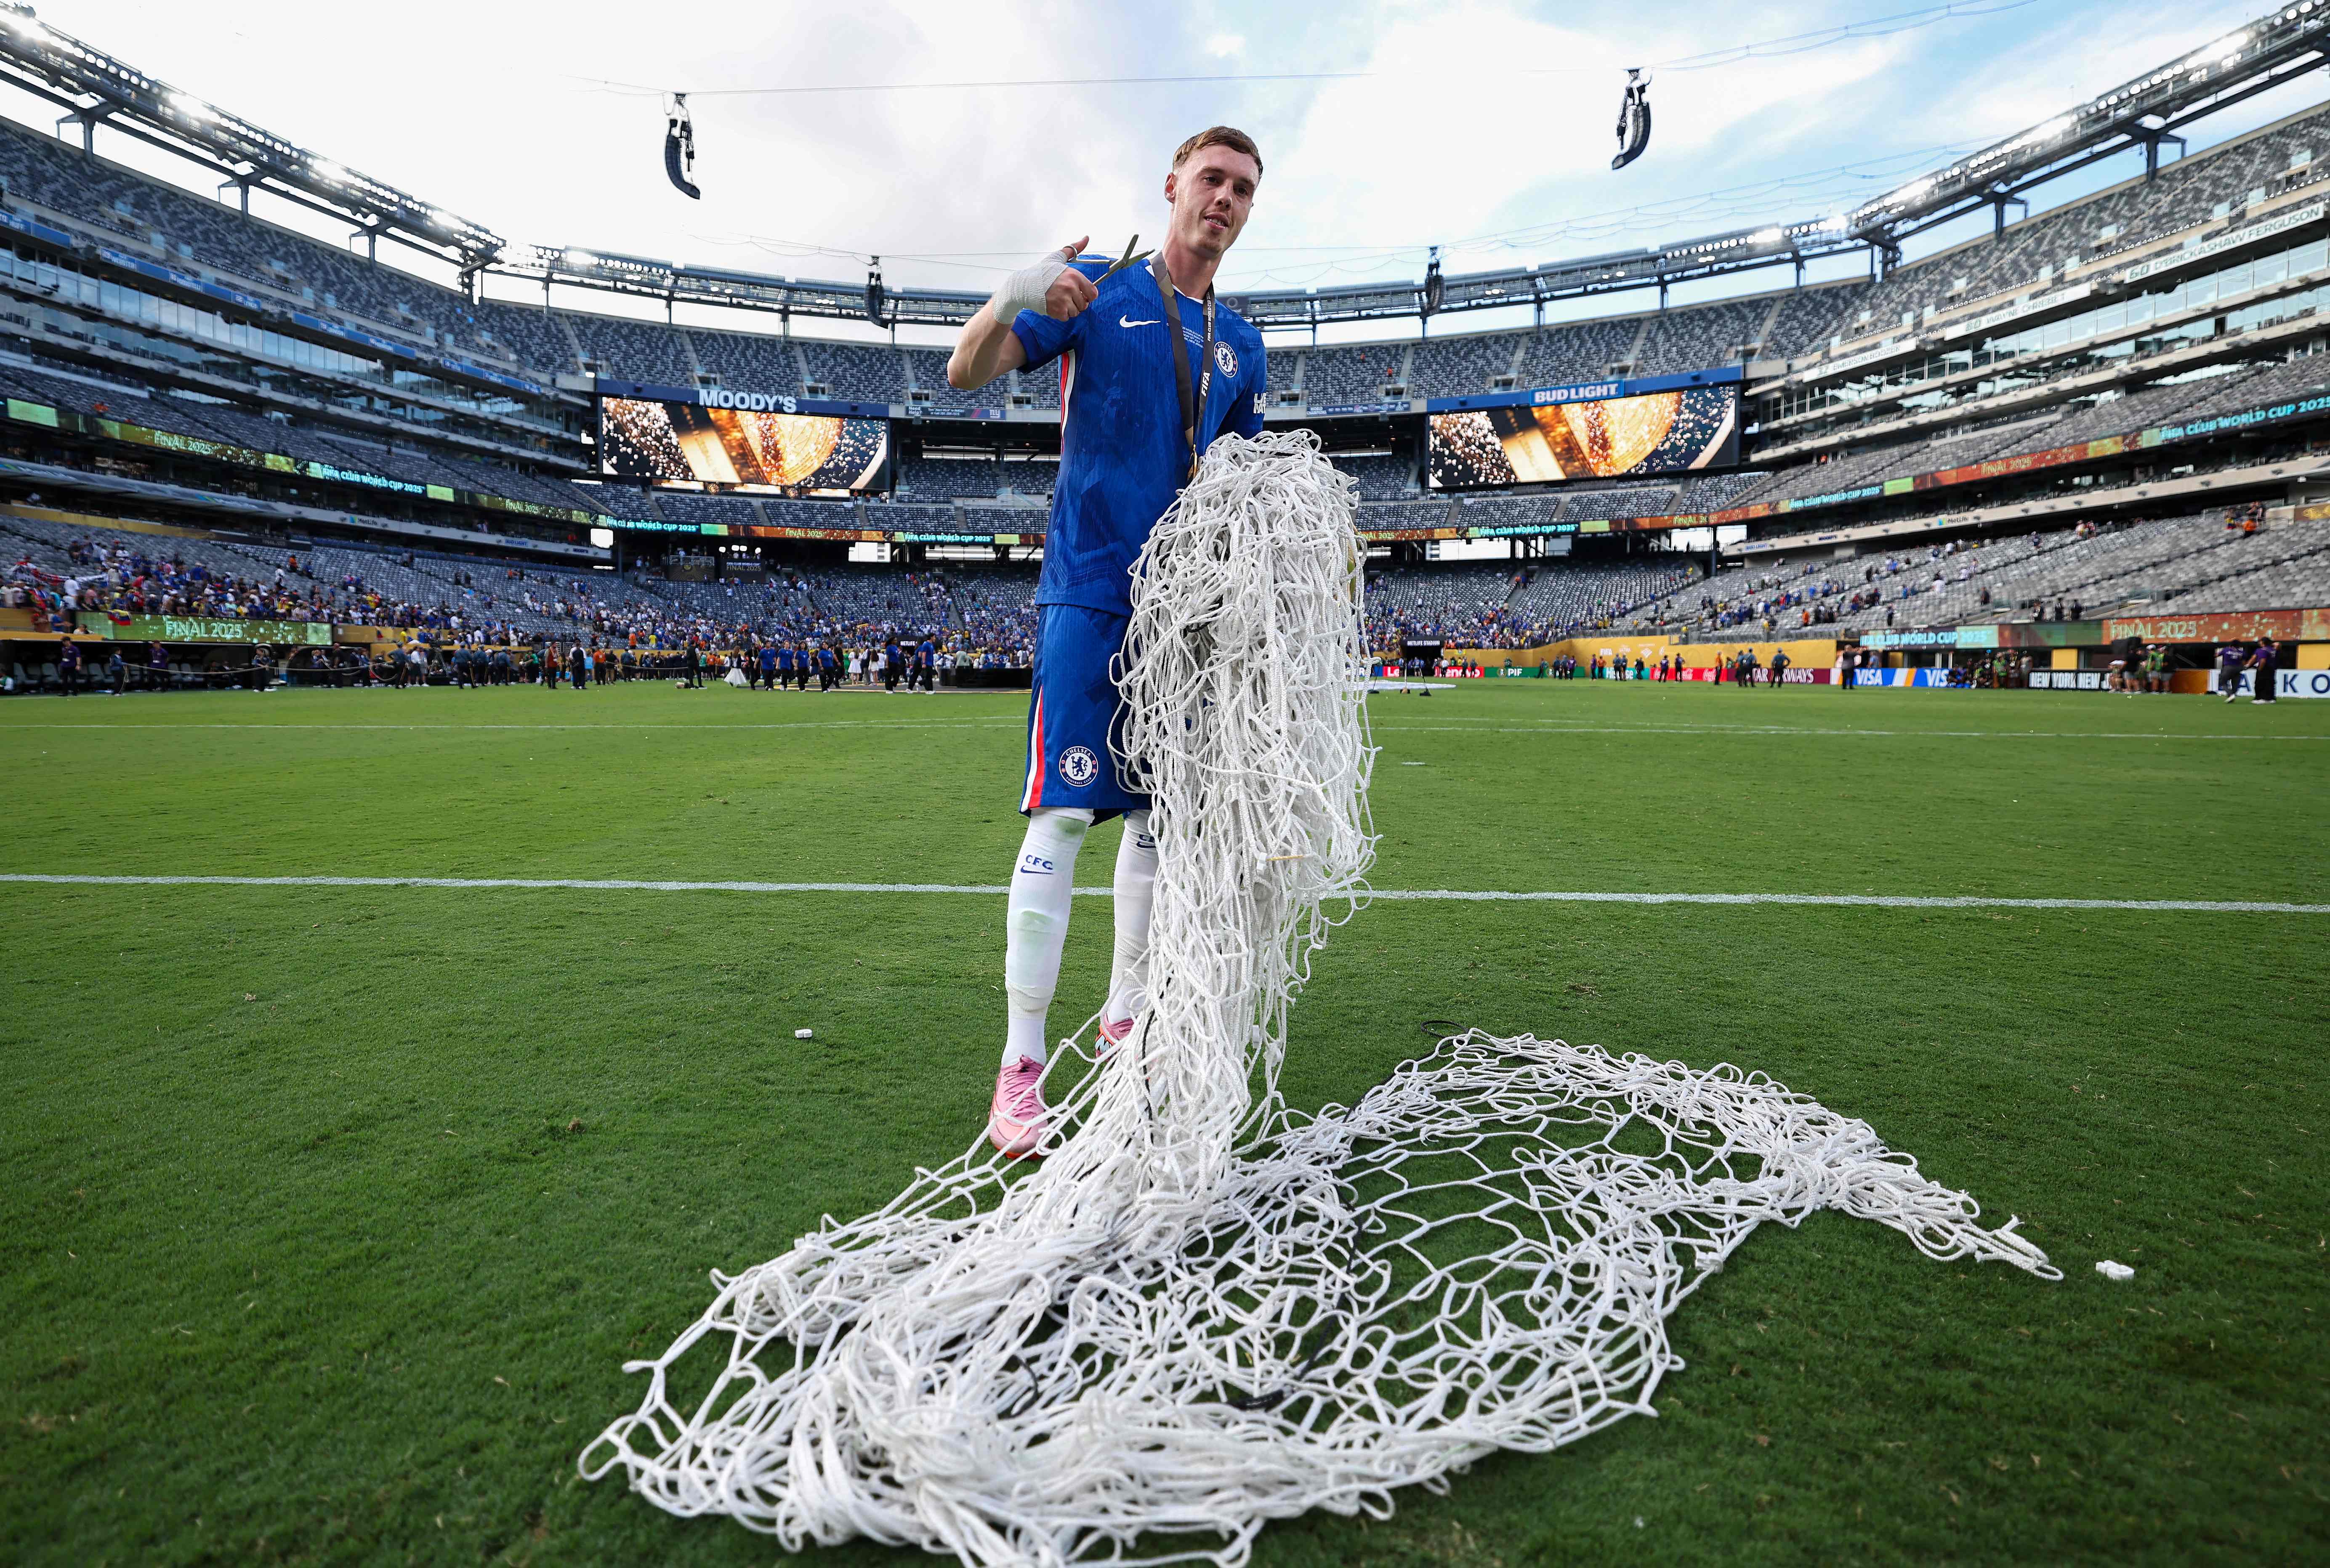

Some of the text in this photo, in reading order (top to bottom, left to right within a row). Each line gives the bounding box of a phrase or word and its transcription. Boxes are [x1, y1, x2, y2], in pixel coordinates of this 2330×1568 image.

[2248, 206, 2321, 239] FERGUSON
[1218, 343, 1234, 356] CHELSEA
[1201, 372, 1210, 397] FIFA
[1534, 383, 1618, 403] BUD LIGHT
[699, 389, 797, 414] MOODY'S
[2185, 420, 2217, 435] CLUB
[2216, 409, 2266, 428] WORLD
[2267, 403, 2296, 419] CUP
[340, 470, 362, 483] CLUB
[361, 474, 388, 488] WORLD
[388, 480, 404, 491] CUP
[617, 520, 636, 529] CLUB
[636, 521, 663, 530] WORLD
[1495, 526, 1514, 536] CLUB
[1514, 526, 1540, 534] WORLD
[1540, 525, 1556, 534] CUP
[165, 621, 243, 638] FINAL 2025
[2111, 621, 2197, 640] FINAL 2025
[1508, 668, 1522, 676] PIF
[1749, 668, 1814, 683] TAR RWAYS
[1854, 668, 1883, 686] VISA
[1925, 669, 1950, 687] VIS
[2029, 672, 2051, 688] NEW
[2051, 672, 2077, 689] YORK
[2077, 672, 2101, 689] NEW
[1066, 748, 1091, 757] CHELSEA
[1025, 854, 1053, 870] CFC
